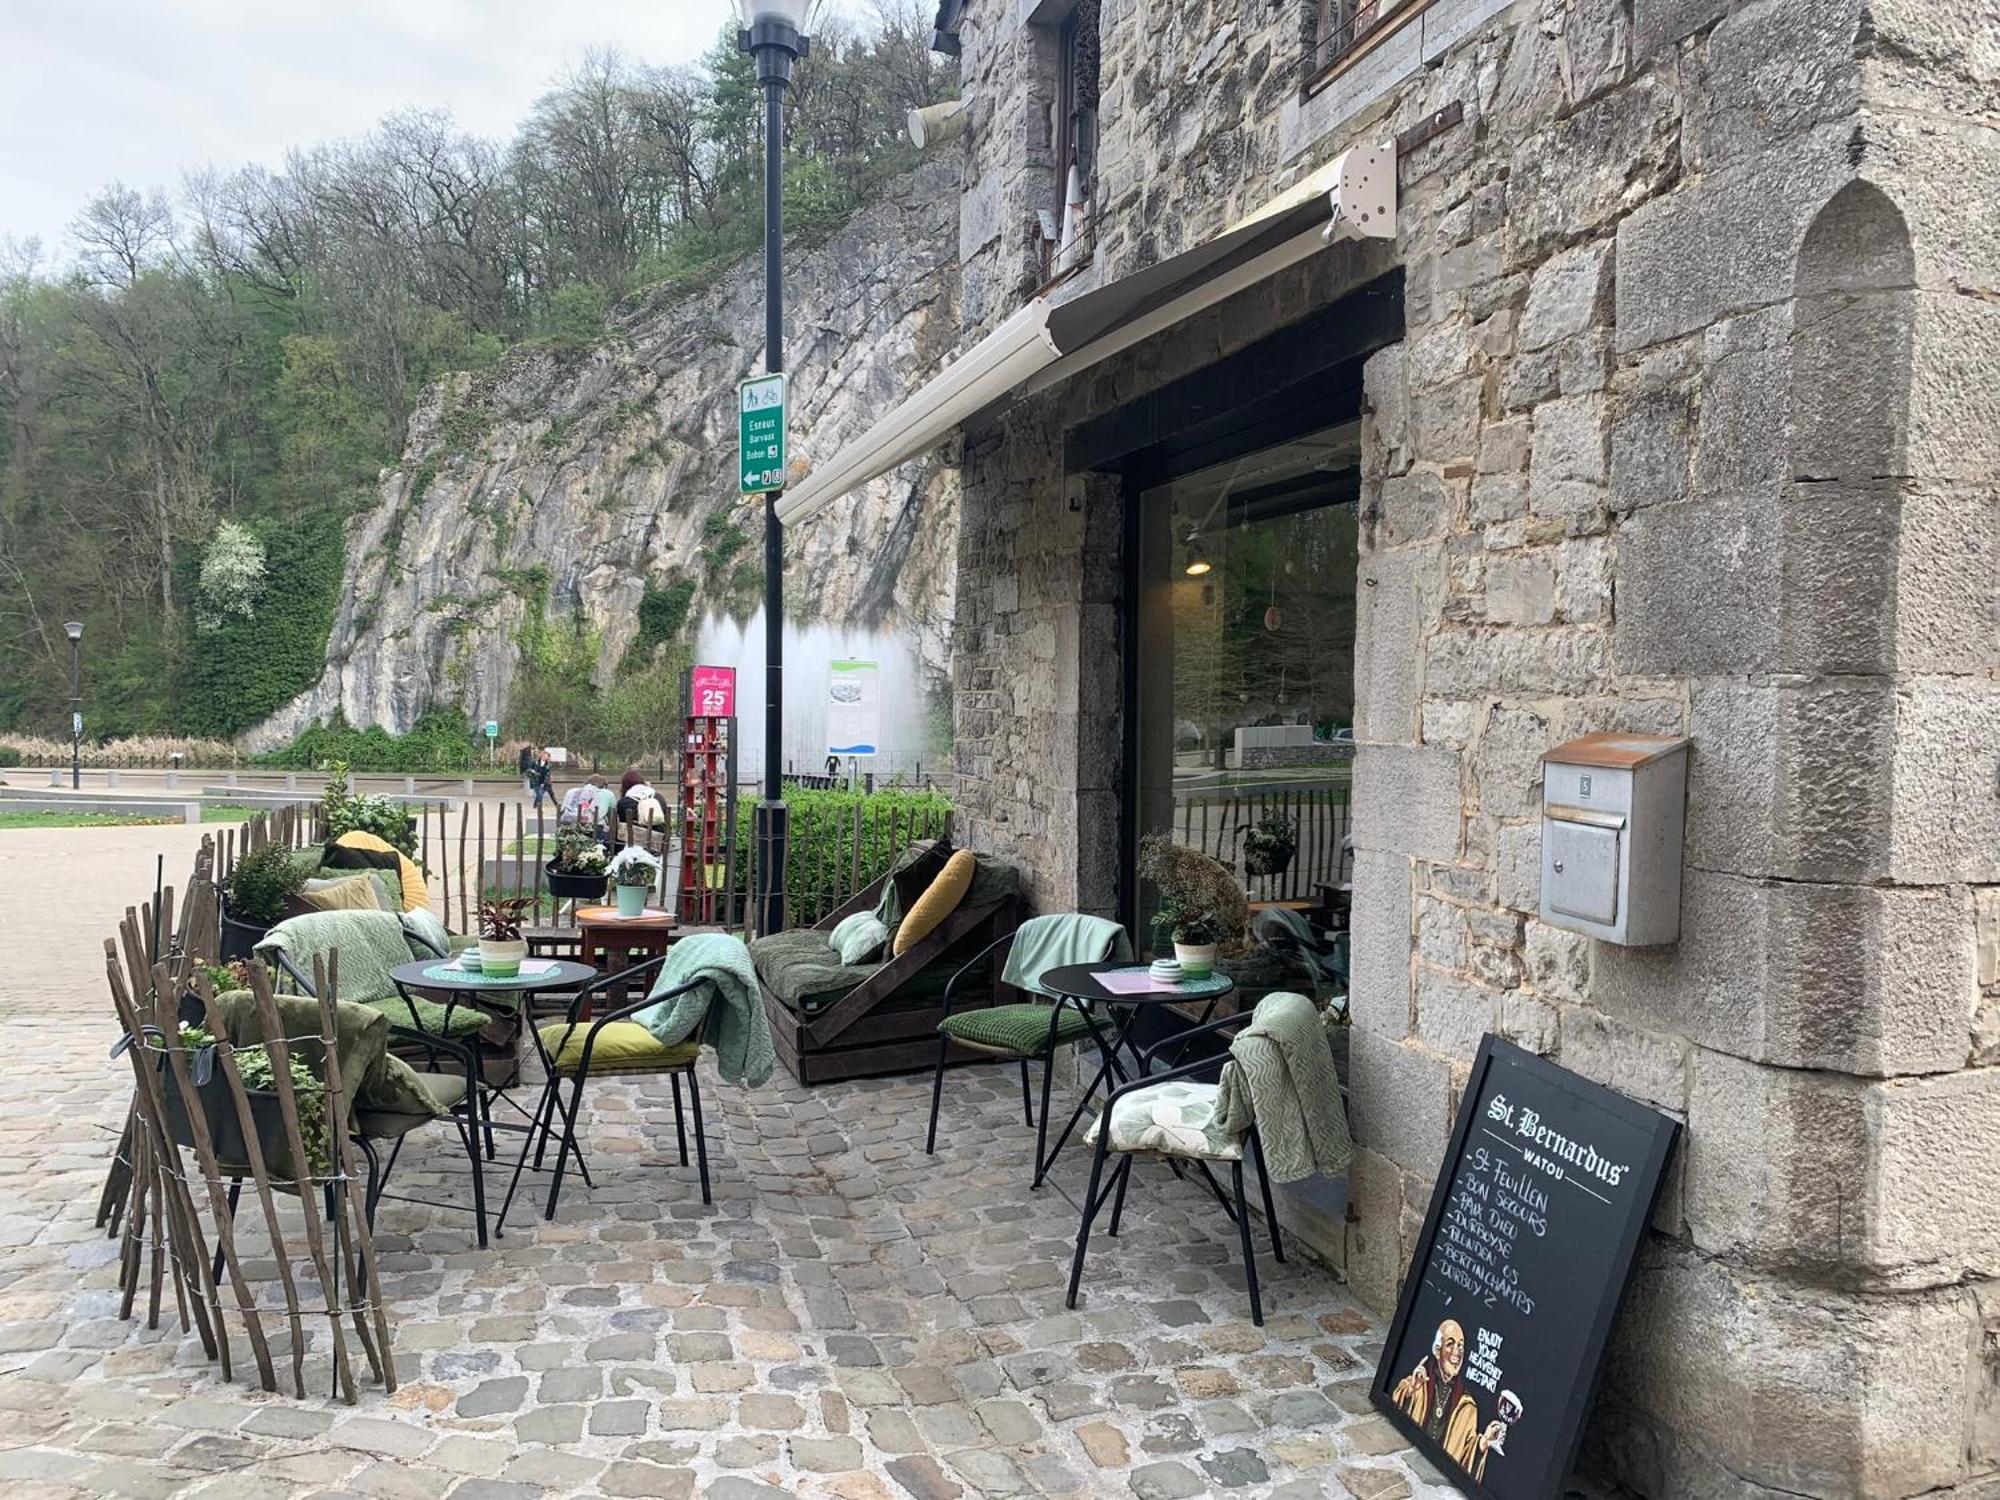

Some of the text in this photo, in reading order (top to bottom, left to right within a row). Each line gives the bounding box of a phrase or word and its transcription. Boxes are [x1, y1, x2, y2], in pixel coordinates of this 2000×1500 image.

[748, 419, 776, 431] Esneux
[749, 433, 775, 444] Barvaux
[702, 689, 725, 705] 25
[1487, 1093, 1626, 1186] St. Bernardus
[1523, 1148, 1566, 1180] WATOU
[1477, 1327, 1503, 1349] ENJOY
[1478, 1342, 1498, 1364] YOUR
[1468, 1350, 1503, 1380] HEAVENLY
